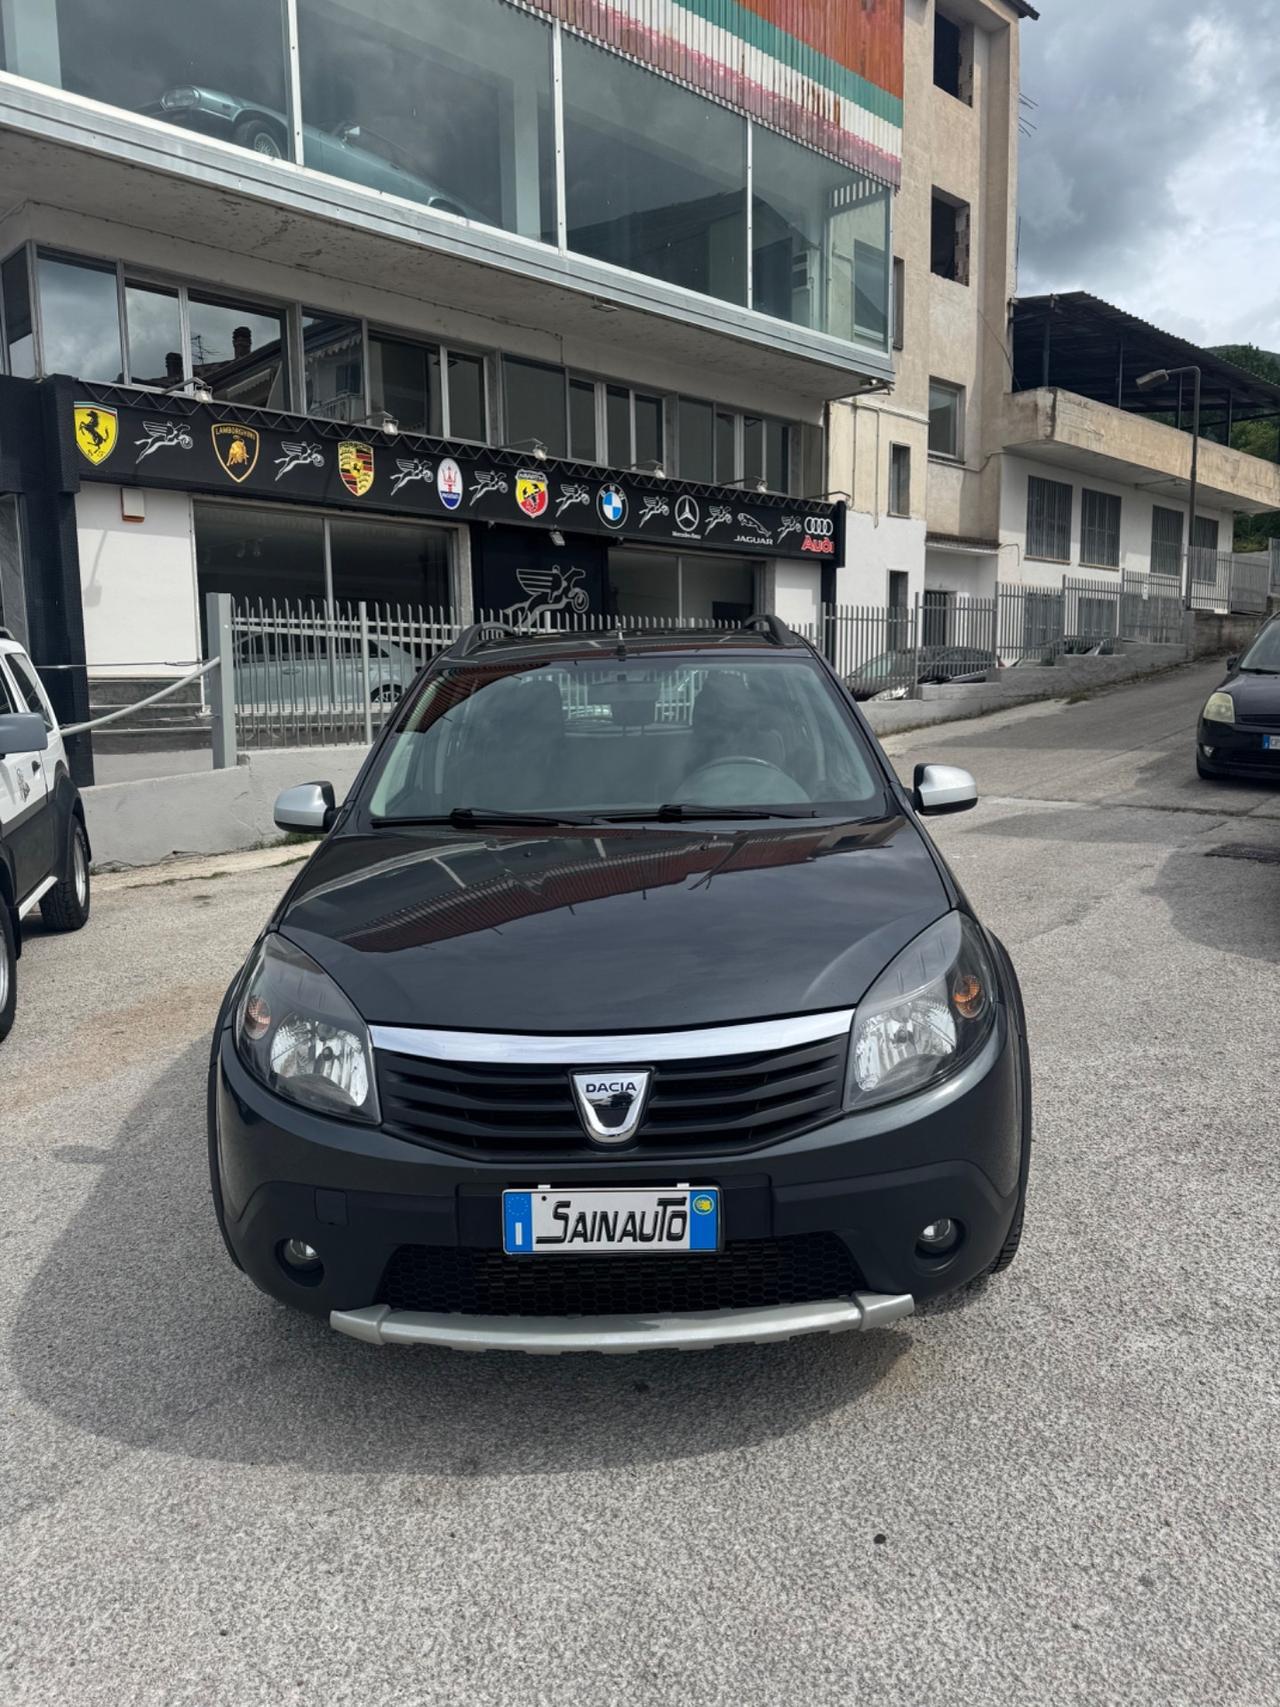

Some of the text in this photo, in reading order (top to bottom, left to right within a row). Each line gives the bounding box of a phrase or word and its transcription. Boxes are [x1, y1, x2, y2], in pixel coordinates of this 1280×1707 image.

[734, 535, 773, 545] JAGUAR
[801, 535, 834, 554] Audi
[586, 1082, 637, 1093] DACIA
